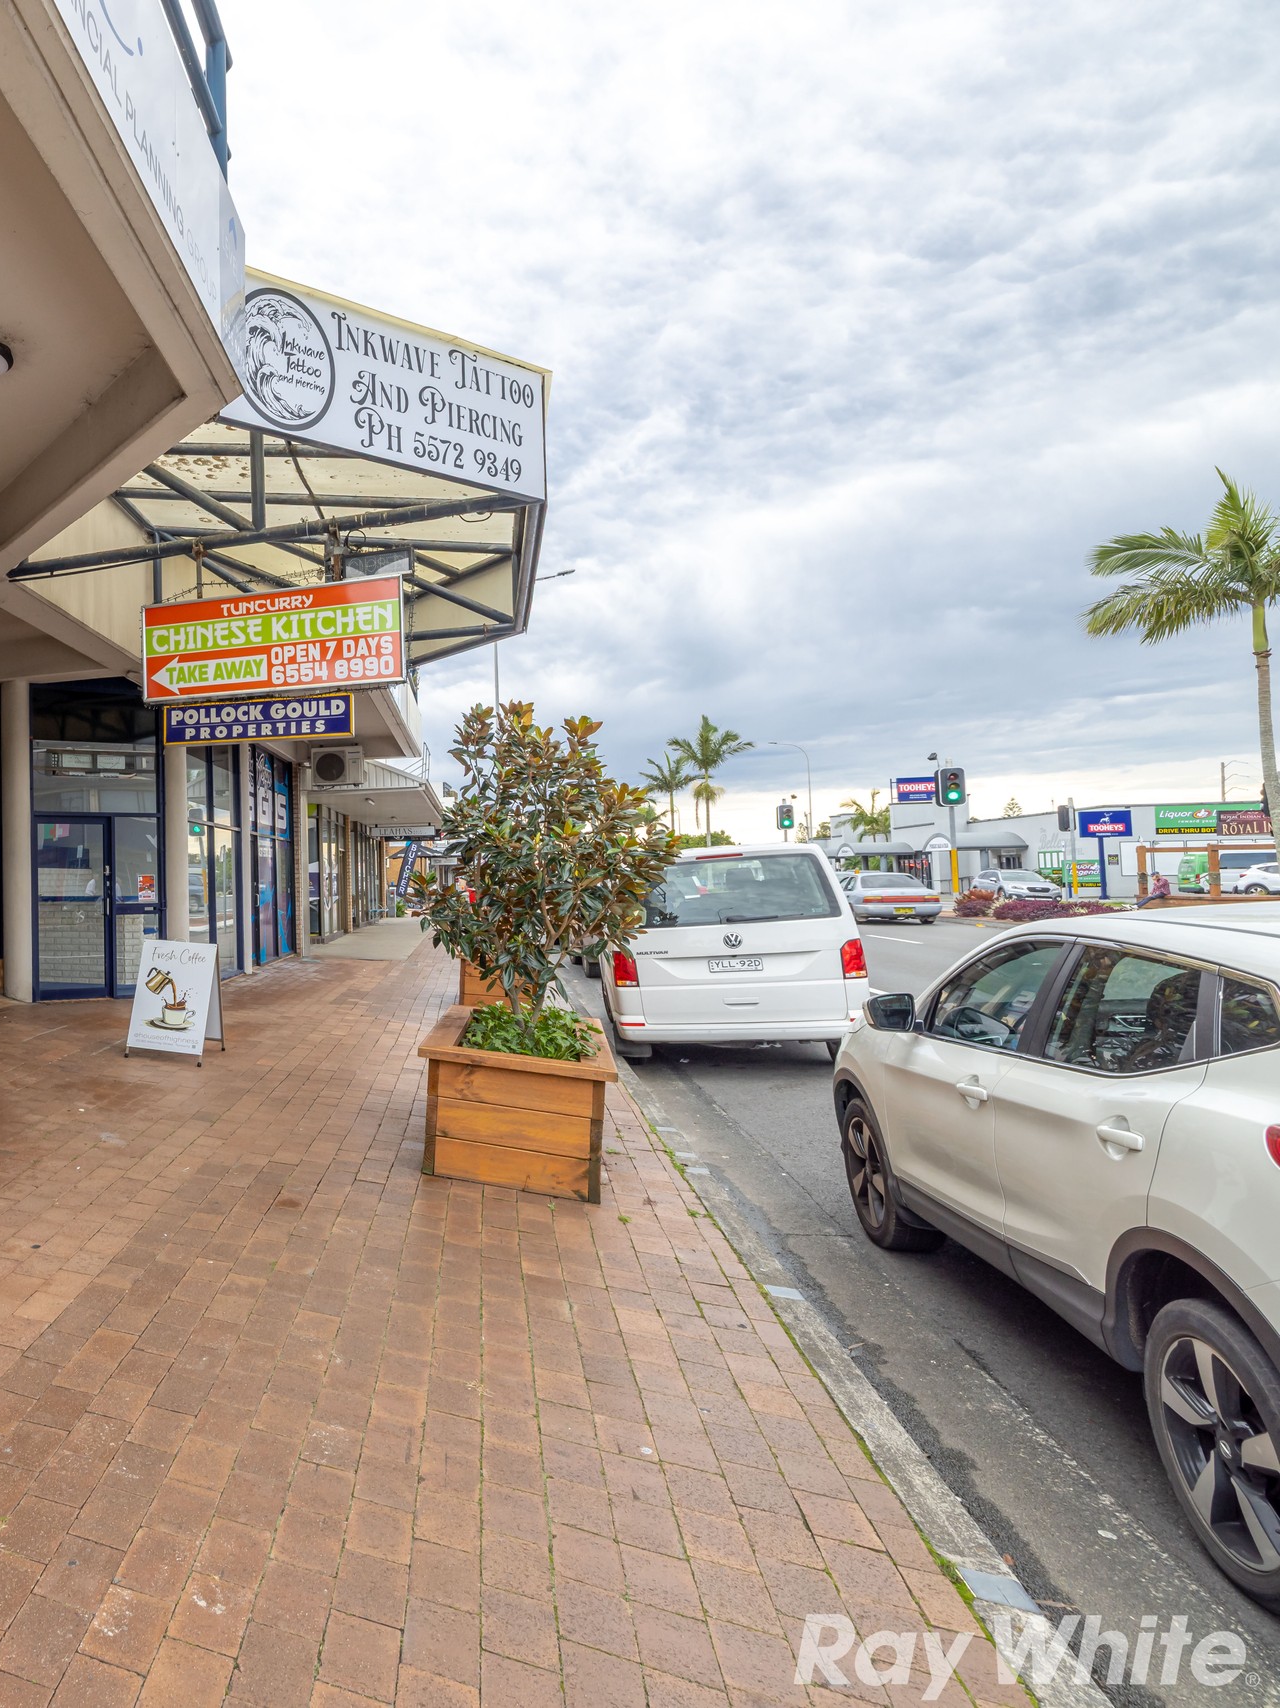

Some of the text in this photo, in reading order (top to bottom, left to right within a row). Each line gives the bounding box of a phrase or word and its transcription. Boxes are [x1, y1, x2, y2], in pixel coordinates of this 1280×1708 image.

[125, 90, 184, 239] PLANNING
[186, 229, 217, 303] GROUP
[281, 331, 325, 361] Inkwave
[284, 352, 322, 378] Tattoo
[278, 373, 325, 395] and piercing
[418, 385, 523, 447] PIERCING
[354, 406, 522, 483] PH 5572 9349
[220, 594, 313, 616] TUNCURRY
[152, 603, 393, 652] CHINESE KITCHEN
[270, 635, 393, 665] OPEN 7 DAYS
[165, 658, 264, 685] TAKE AWAY
[271, 655, 394, 685] 6554 8990
[171, 699, 346, 726] POLLOCK GOULD
[185, 719, 326, 740] PROPERTIES
[898, 783, 935, 792] TOOHEYS
[1159, 810, 1192, 820] Liquor
[1222, 822, 1259, 835] ROYAL
[399, 844, 418, 895] BUTCHER
[152, 947, 206, 965] Fresh Coffee
